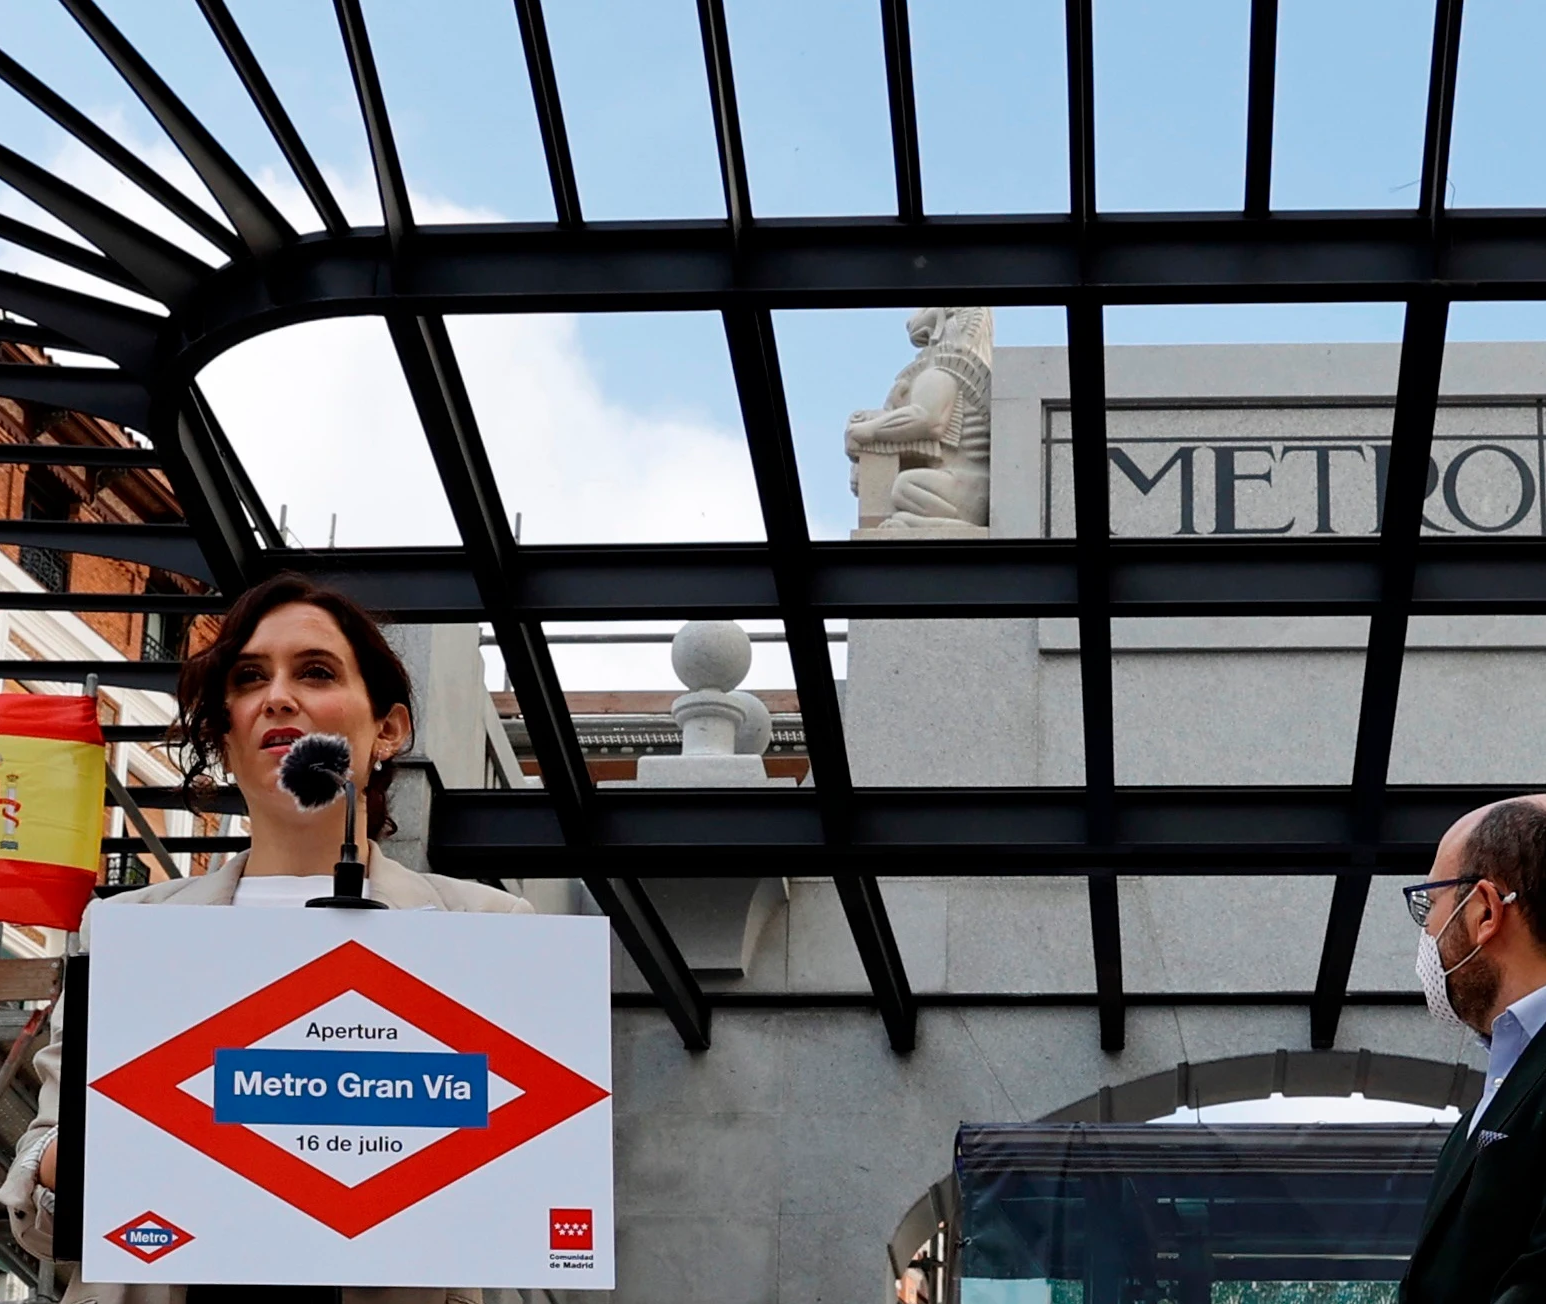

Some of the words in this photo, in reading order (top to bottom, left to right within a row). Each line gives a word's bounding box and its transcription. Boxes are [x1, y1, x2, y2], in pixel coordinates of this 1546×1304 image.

[306, 1022, 398, 1041] Apertura
[233, 1070, 327, 1098] Metro
[337, 1072, 413, 1099] Gran
[422, 1074, 471, 1100] Vía
[296, 1135, 319, 1152] 16
[326, 1135, 352, 1152] de
[358, 1135, 403, 1155] julio
[129, 1231, 168, 1245] Metro
[549, 1253, 594, 1261] Comunidad
